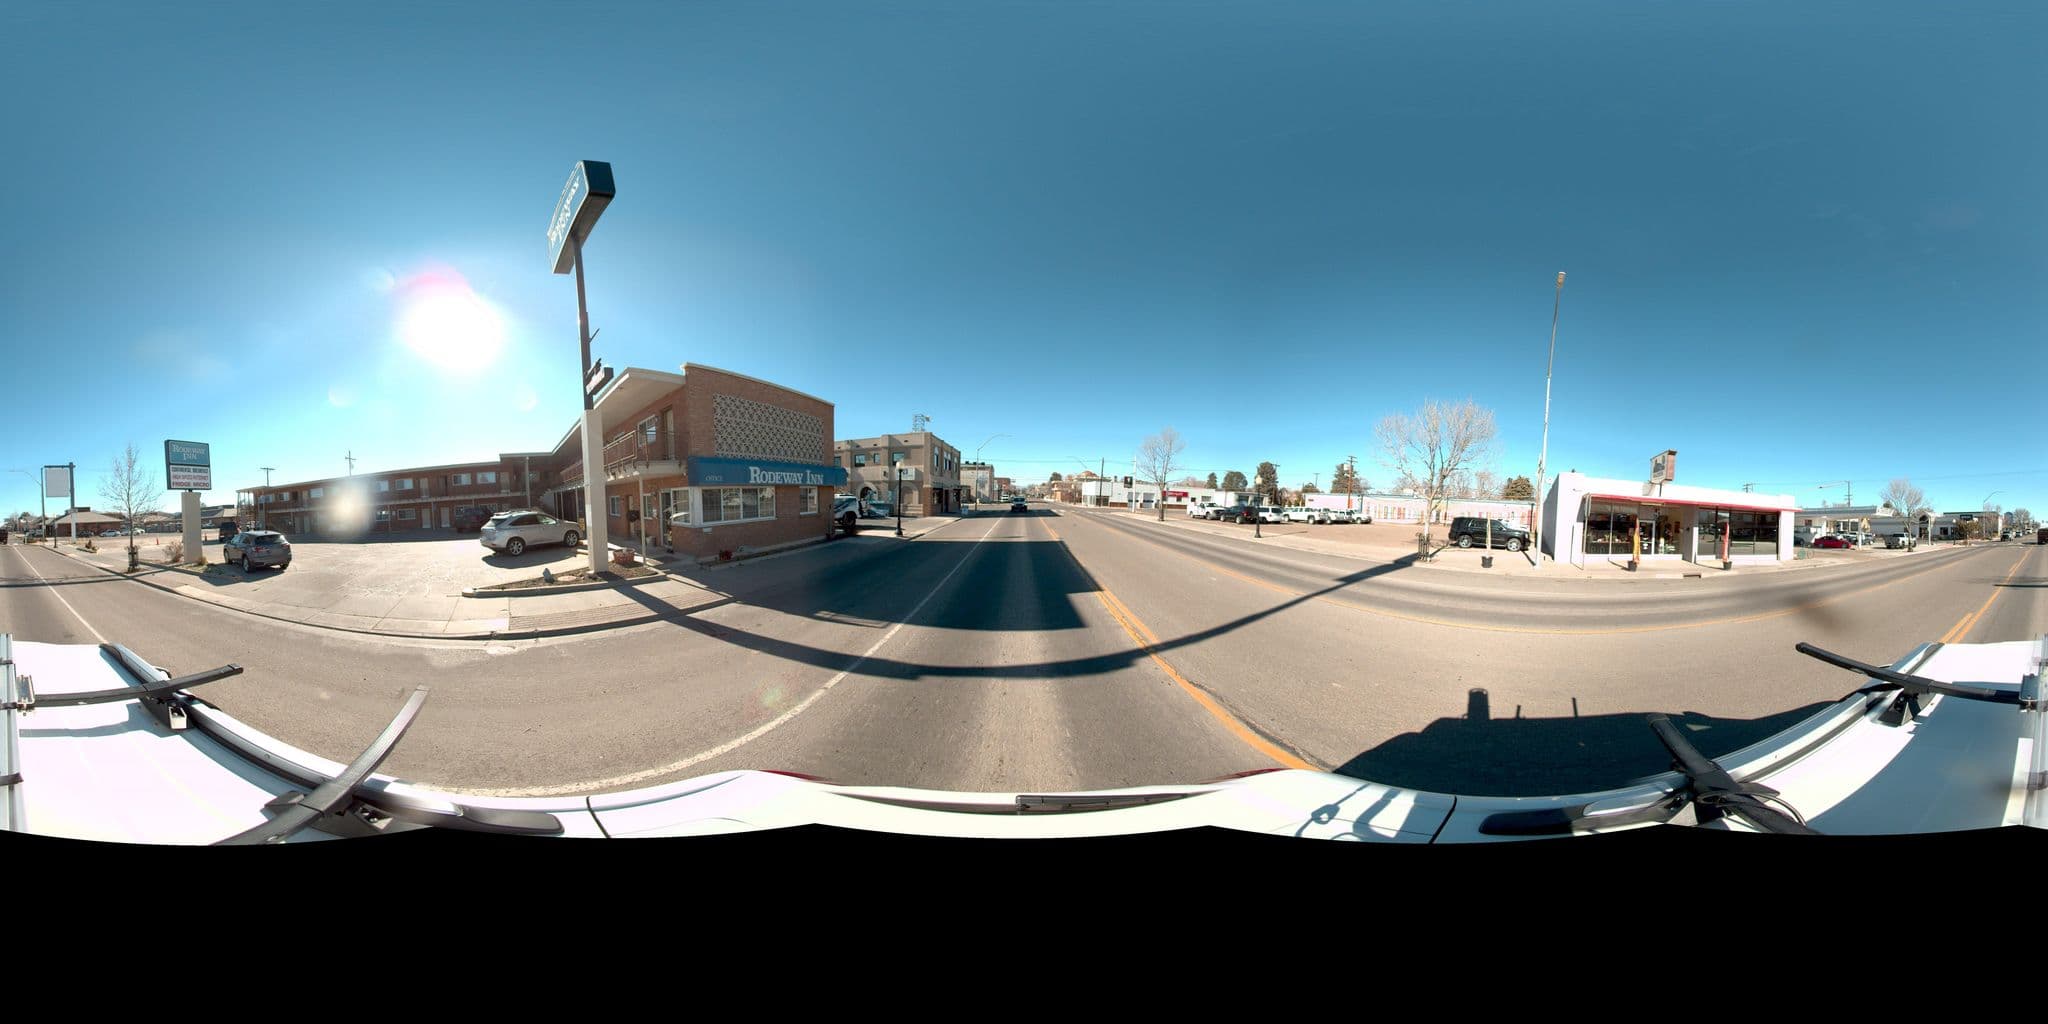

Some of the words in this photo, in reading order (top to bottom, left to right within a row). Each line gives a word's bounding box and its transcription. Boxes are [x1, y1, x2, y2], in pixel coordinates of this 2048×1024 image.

[183, 452, 197, 460] INN
[748, 466, 804, 485] RODEWAY
[805, 469, 824, 485] INN
